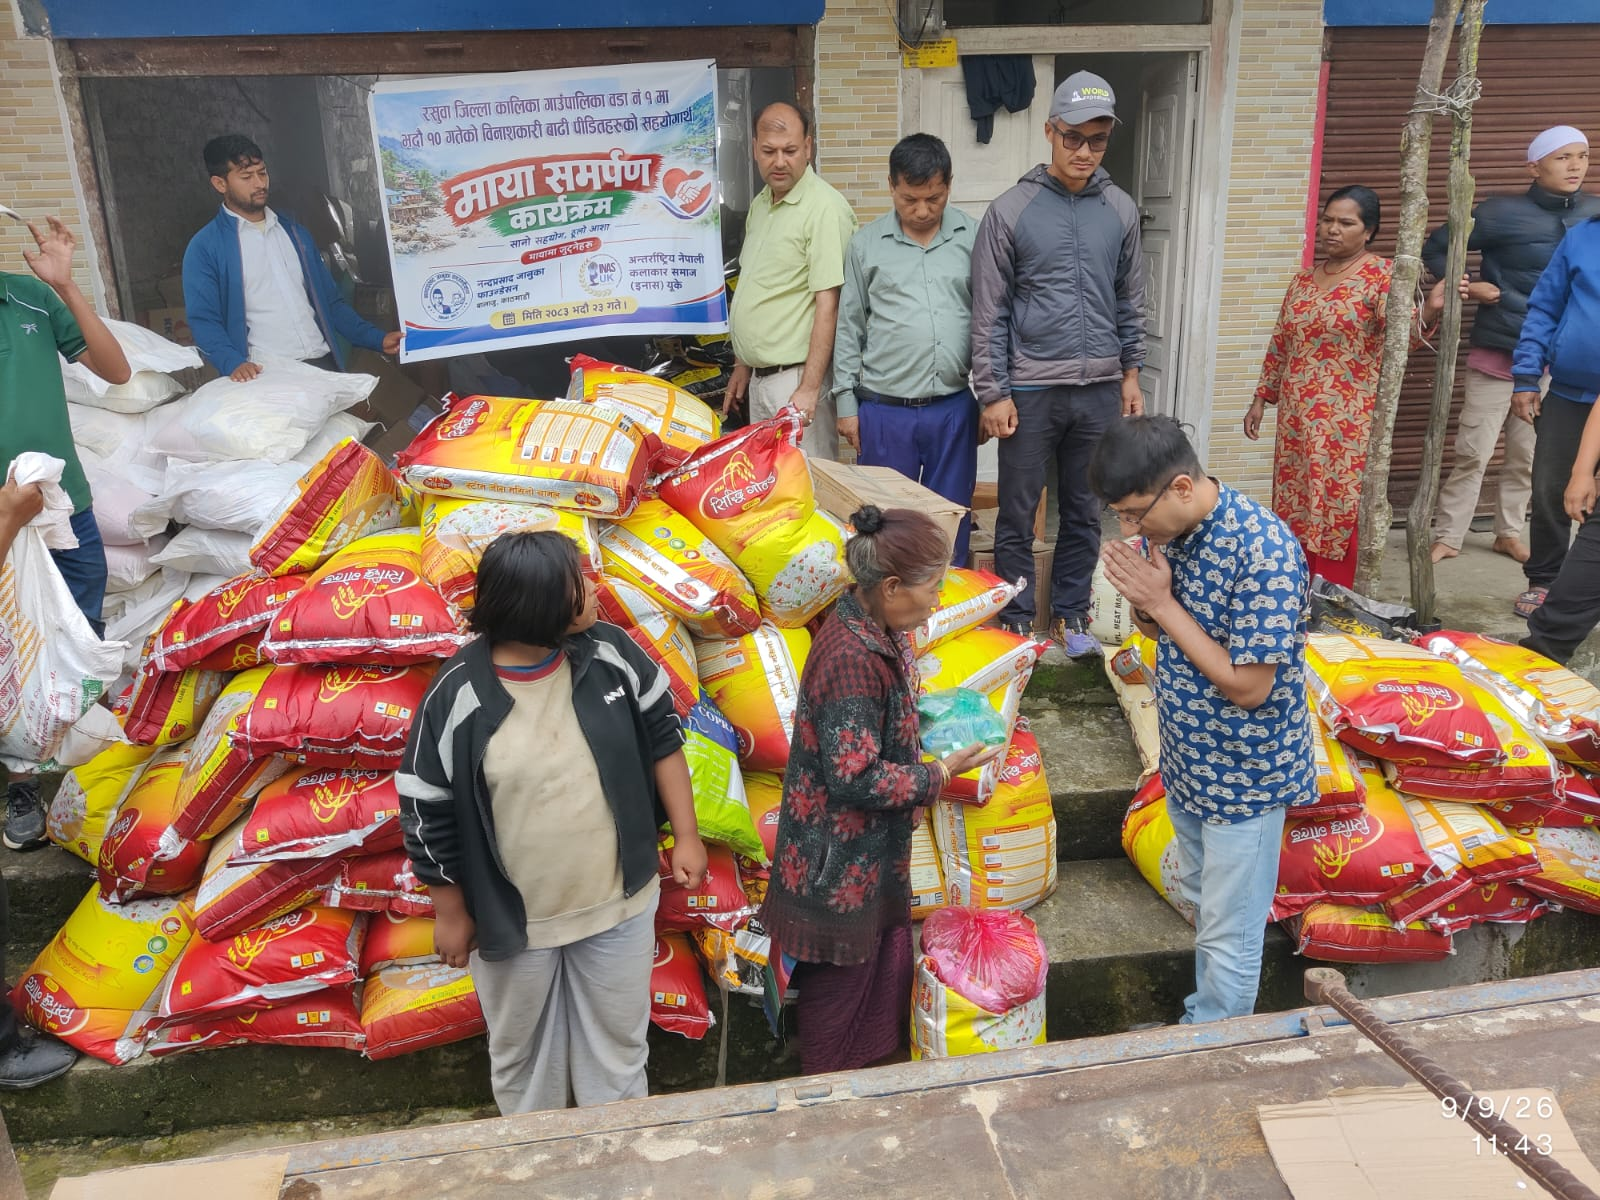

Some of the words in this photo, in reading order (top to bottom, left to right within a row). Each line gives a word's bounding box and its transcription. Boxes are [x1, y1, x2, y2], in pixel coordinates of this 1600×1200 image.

[1081, 87, 1110, 97] WORLD
[422, 105, 452, 123] रसुवा
[454, 100, 491, 118] जिल्ला
[495, 95, 540, 115] कालिका
[609, 92, 628, 107] वडा
[632, 88, 642, 105] नं
[645, 89, 653, 105] १
[655, 90, 669, 104] मा
[401, 128, 424, 148] भदौ
[427, 132, 442, 147] १०
[445, 125, 478, 145] गतेको
[482, 119, 543, 142] विनाशकारी
[450, 165, 536, 219] माया
[543, 148, 652, 195] समर्पण
[508, 195, 614, 231] कार्यक्रम
[510, 236, 531, 249] सानो
[589, 223, 610, 233] आशा
[600, 262, 616, 273] INAS
[678, 252, 705, 265] नेपाली
[600, 274, 614, 283] UK
[629, 268, 668, 278] कलाकार
[671, 268, 697, 277] समाज
[630, 280, 664, 292] (इनास)
[522, 309, 542, 321] मिति
[545, 308, 569, 318] २०८३
[572, 302, 590, 314] भदौ
[593, 303, 604, 313] २३
[606, 299, 621, 311] गते
[710, 487, 747, 515] सिद्धि
[746, 472, 777, 495] गोल्ड
[321, 571, 362, 586] गोल्ड
[363, 568, 405, 584] सिद्धि
[698, 706, 735, 735] COPRA
[1290, 825, 1328, 843] गोल्ड
[1329, 815, 1370, 838] सिद्धि
